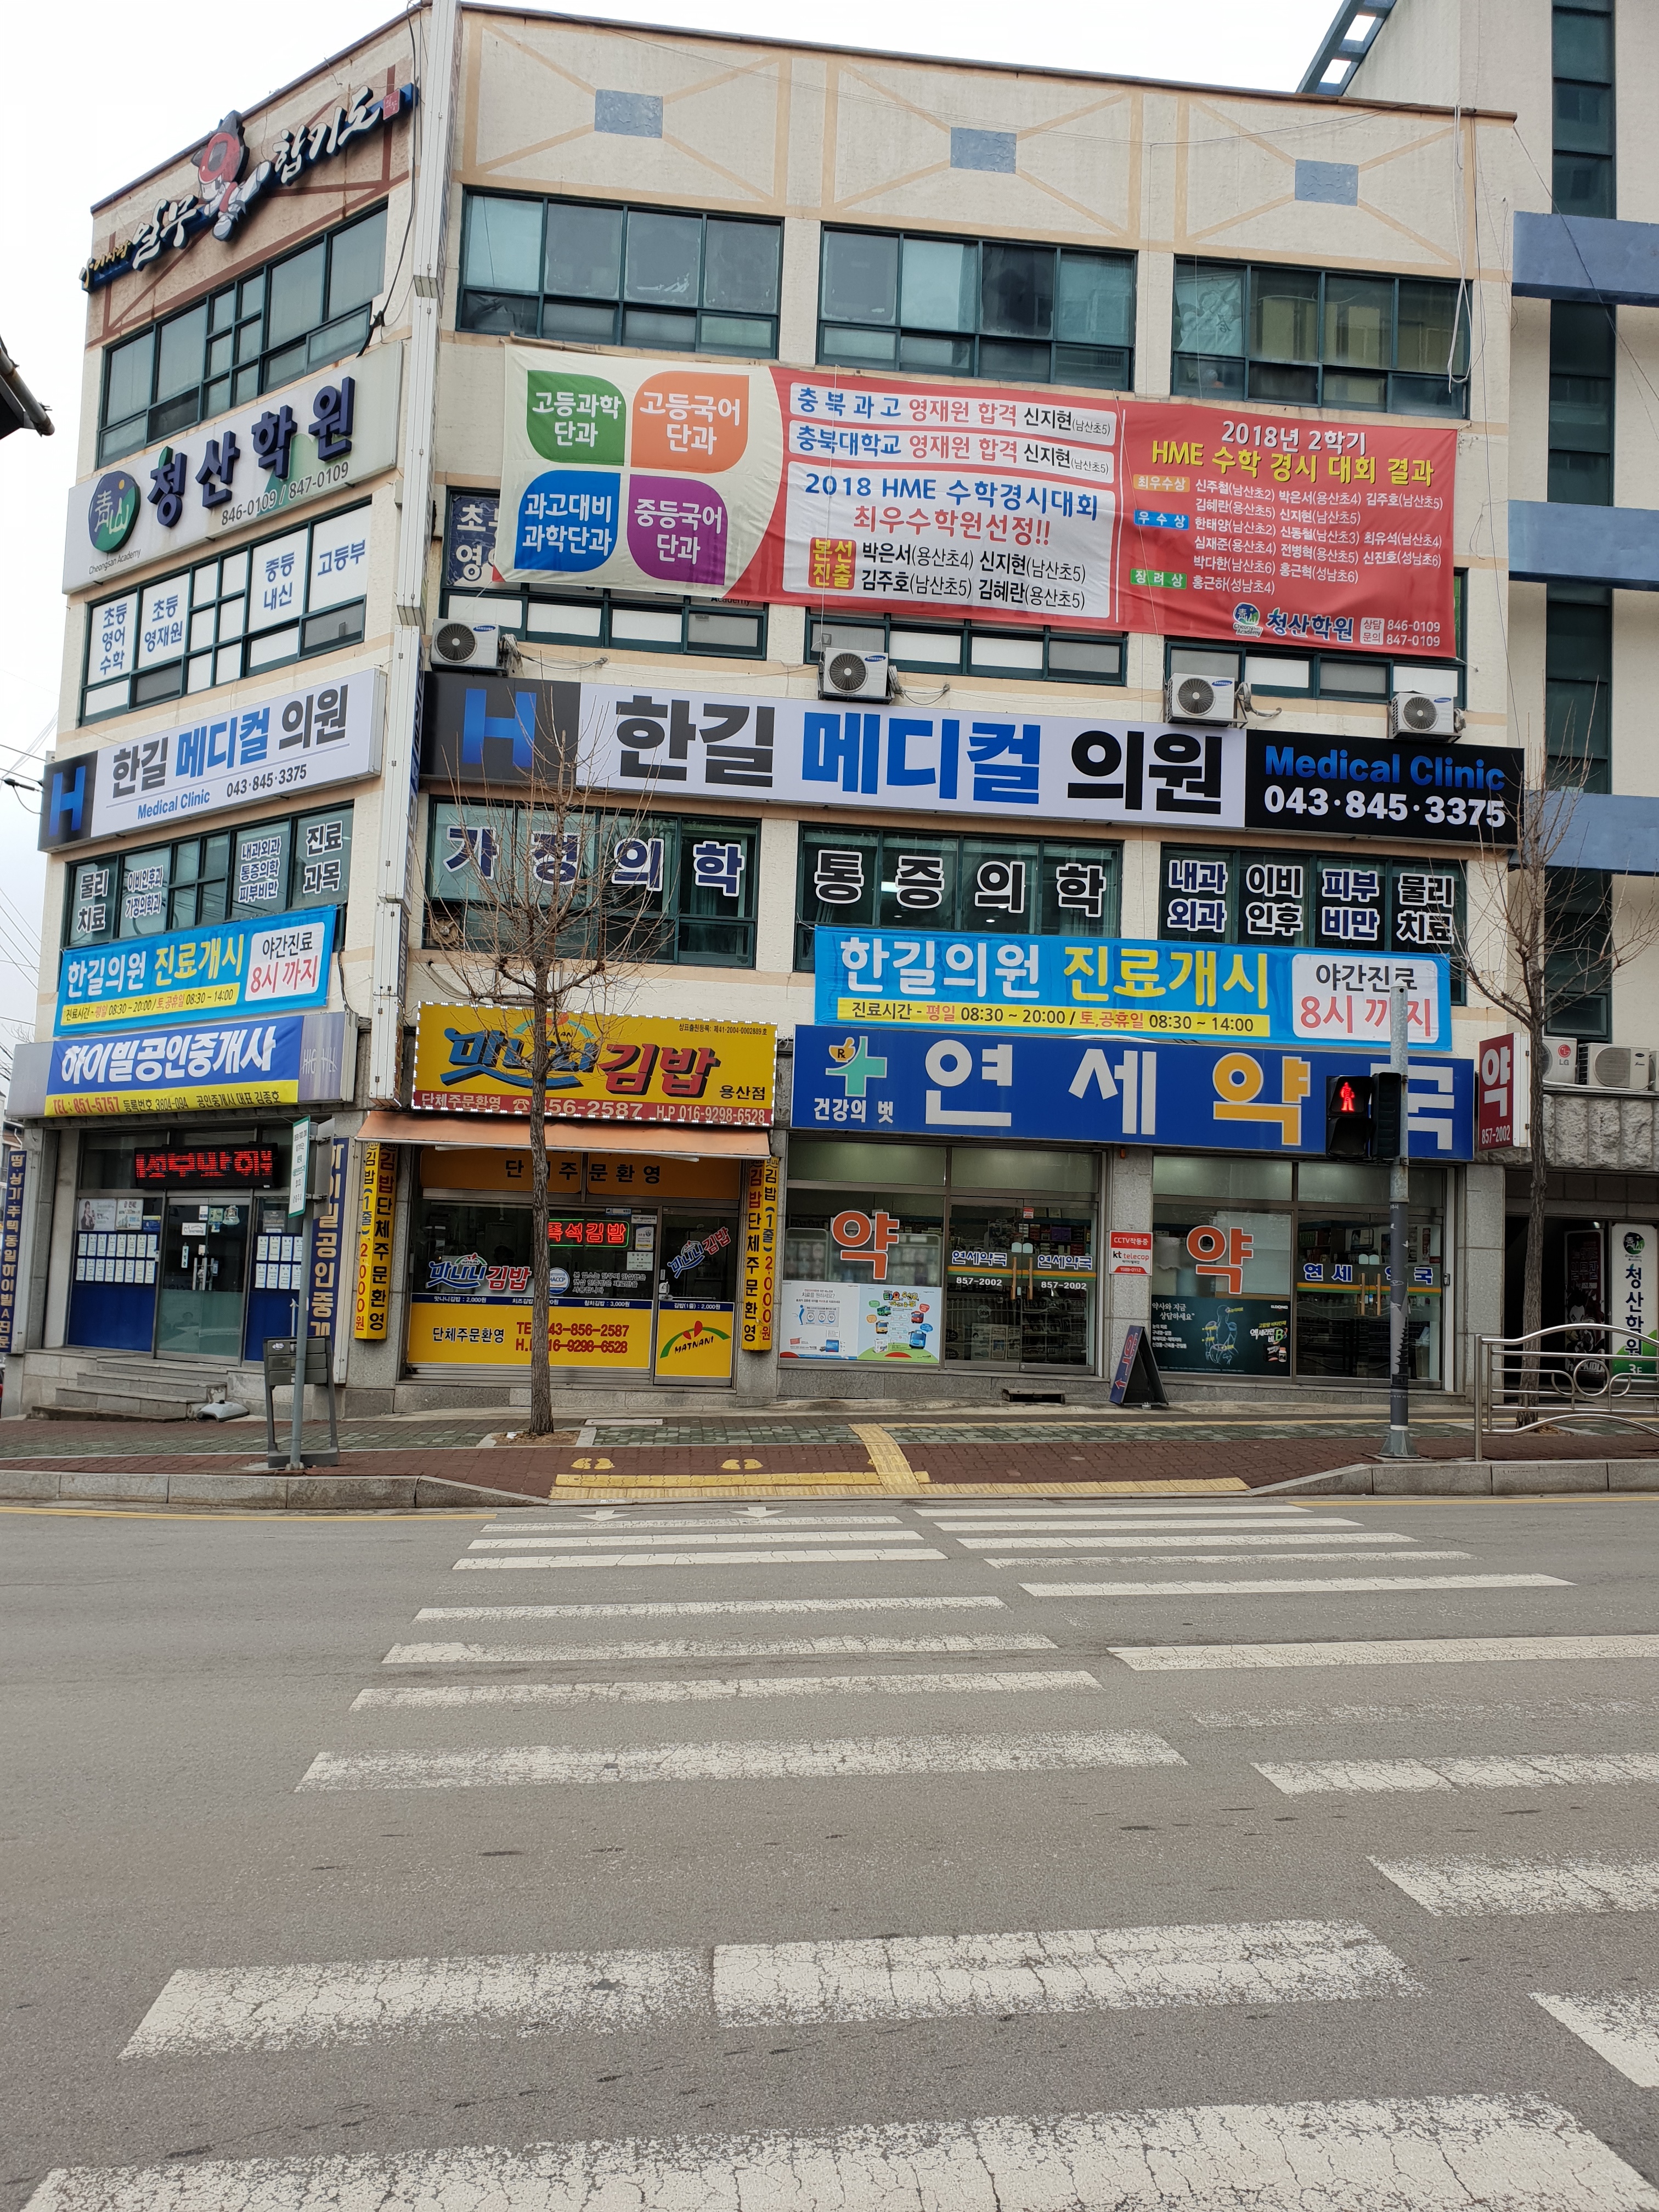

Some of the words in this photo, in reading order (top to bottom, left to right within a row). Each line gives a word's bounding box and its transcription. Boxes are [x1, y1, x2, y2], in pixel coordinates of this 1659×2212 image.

[273, 85, 381, 184] 합기도
[532, 392, 621, 420] 고등과학
[639, 391, 740, 426] 고등국어
[909, 398, 969, 424] 영재원
[978, 402, 1017, 427] 합격
[554, 422, 598, 448] 단과
[667, 424, 717, 455] 단과
[797, 425, 902, 458] 충북대학교
[909, 435, 970, 460] 영재원
[979, 437, 1018, 464] 합격
[1222, 420, 1300, 452] 2018년
[1308, 430, 1367, 455] 2학기
[147, 376, 356, 528] 청산학원
[1152, 440, 1203, 466] HME
[1212, 446, 1261, 477] 수학
[1270, 452, 1318, 483] 경시
[1328, 455, 1376, 484] 대회
[1387, 457, 1435, 487] 결과
[221, 491, 276, 526] 846-0109
[289, 461, 349, 499] 847-0109
[805, 472, 872, 497] 2018
[882, 477, 937, 501] HME
[946, 478, 1098, 521] 수학경시대회
[1137, 475, 1186, 492] 최우수상
[524, 493, 612, 523] 과고대비
[634, 498, 722, 534] 중등국어
[522, 524, 612, 556] 과학단과
[854, 505, 1051, 546] 최우수학원선정!!
[89, 557, 117, 575] Cheongsan
[117, 549, 142, 565] Academy
[317, 538, 365, 577] 고등부
[657, 534, 701, 565] 단과
[812, 538, 853, 563] 본선
[266, 551, 295, 583] 중등
[812, 563, 853, 589] 진출
[152, 595, 178, 622] 초등
[264, 582, 292, 611] 내신
[103, 602, 127, 629] 초등
[1266, 607, 1355, 643] 청산학원
[1363, 618, 1383, 630] 상담
[1387, 619, 1441, 633] 846-0109
[102, 627, 125, 652] 영어
[144, 620, 183, 653] 영재원
[1363, 633, 1381, 644] 문의
[1386, 634, 1441, 647] 847-0109
[100, 650, 125, 675] 수학
[112, 737, 169, 798] 한길
[176, 707, 270, 778] 메디컬
[279, 685, 348, 750] 의원
[616, 695, 775, 788] 한길
[802, 711, 1041, 805] 메디컬
[1068, 730, 1222, 815] 의원
[1265, 745, 1400, 784] Medical
[1410, 755, 1505, 791] Clinic
[138, 799, 178, 820] Medical
[180, 789, 210, 809] Clinic
[241, 836, 282, 861] 내과외과
[306, 820, 343, 857] 진료
[80, 869, 109, 901] 물리
[127, 865, 163, 892] 이비인후과
[240, 859, 280, 883] 통증의학
[303, 859, 341, 894] 과목
[1168, 860, 1228, 894] 내과
[1246, 863, 1304, 899] 이비
[1322, 867, 1379, 903] 피부
[238, 879, 278, 904] 피부비만
[1398, 872, 1454, 908] 물리
[77, 904, 106, 934] 치료
[125, 893, 161, 919] 가정의학과
[1167, 898, 1228, 933] 외과
[1245, 901, 1304, 936] 인후
[1322, 906, 1380, 941] 비만
[1397, 910, 1454, 945] 치료
[262, 932, 313, 960] 야간진료
[67, 951, 147, 998] 한길의원
[155, 934, 245, 986] 진료개시
[250, 964, 279, 994] 8시
[281, 955, 319, 990] 까지
[840, 937, 1040, 998] 한길의원
[1063, 946, 1268, 1009] 진료개시
[1316, 963, 1418, 993] 야간진료
[65, 1006, 89, 1022] 진료시간
[94, 1003, 108, 1019] 평일
[109, 1001, 127, 1016] 08:30
[133, 998, 152, 1013] 20:00
[186, 992, 206, 1005] 08:30
[214, 989, 233, 1001] 14:00
[851, 1001, 912, 1020] 진료시간
[926, 1005, 956, 1023] 평일
[961, 1006, 1003, 1022] 08:30
[1023, 1009, 1066, 1025] 20:00
[1149, 1014, 1192, 1030] 08:30
[1212, 1017, 1254, 1032] 14:00
[1300, 995, 1353, 1034] 8시
[61, 1026, 276, 1085] 하이빌공인중개사
[719, 1085, 765, 1101] 용산점
[1482, 1045, 1511, 1118] 약
[73, 1096, 121, 1115] 851-5757
[123, 1099, 152, 1113] 등록번호
[155, 1097, 188, 1109] 3804-094
[196, 1092, 235, 1108] 공인중개사
[236, 1092, 253, 1106] 대표
[255, 1090, 281, 1105] 김종호
[421, 1093, 501, 1111] 단체주문환영
[680, 1105, 765, 1124] 016-9298-6528
[814, 1098, 866, 1123] 건강의
[878, 1101, 894, 1124] 벗
[1481, 1124, 1511, 1146] 857-2002
[549, 1222, 627, 1243] 즉석김밥
[832, 1209, 900, 1280] 약
[952, 1250, 1007, 1267] 연세약국
[1037, 1254, 1093, 1271] 연세약국
[1186, 1224, 1254, 1295] 약
[956, 1276, 1003, 1287] 857-2002
[1041, 1280, 1087, 1290] 857-2002
[1152, 1302, 1172, 1312] 약사와
[1173, 1304, 1187, 1312] 지금
[433, 1327, 505, 1344] 단체주문환영
[674, 1335, 714, 1355] MATNANI
